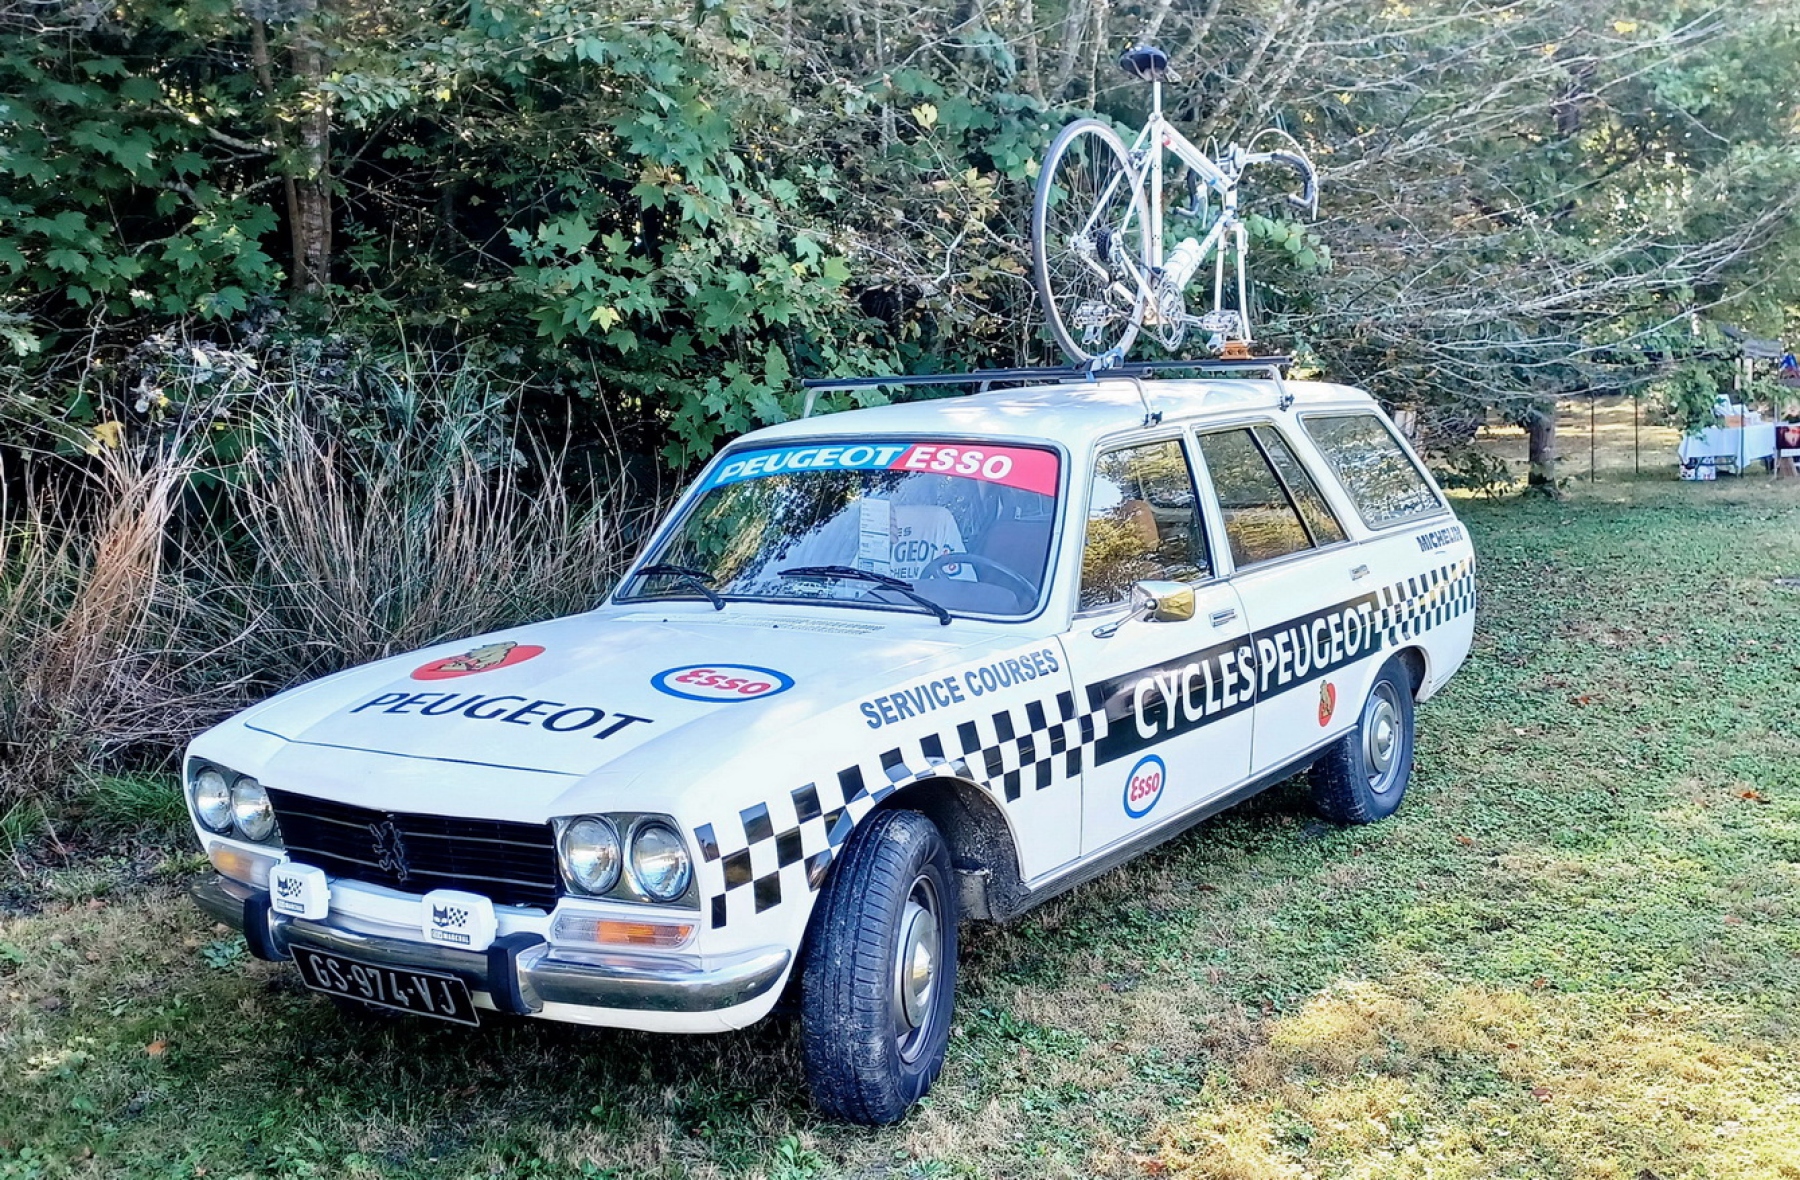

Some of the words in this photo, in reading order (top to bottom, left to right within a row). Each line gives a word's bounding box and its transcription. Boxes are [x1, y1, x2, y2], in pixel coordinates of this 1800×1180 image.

[715, 446, 903, 484] PEUGEOT
[905, 446, 1013, 480] ESSO
[894, 540, 938, 563] GEOT
[1416, 526, 1463, 552] MICHELIN
[859, 676, 966, 730] SERVICE
[964, 648, 1060, 697] COURSES
[1133, 647, 1256, 740] CYCLES
[1257, 601, 1374, 693] PEUGEOT
[349, 692, 655, 740] PEUGEOT
[308, 953, 457, 1016] GS-974-VJ
